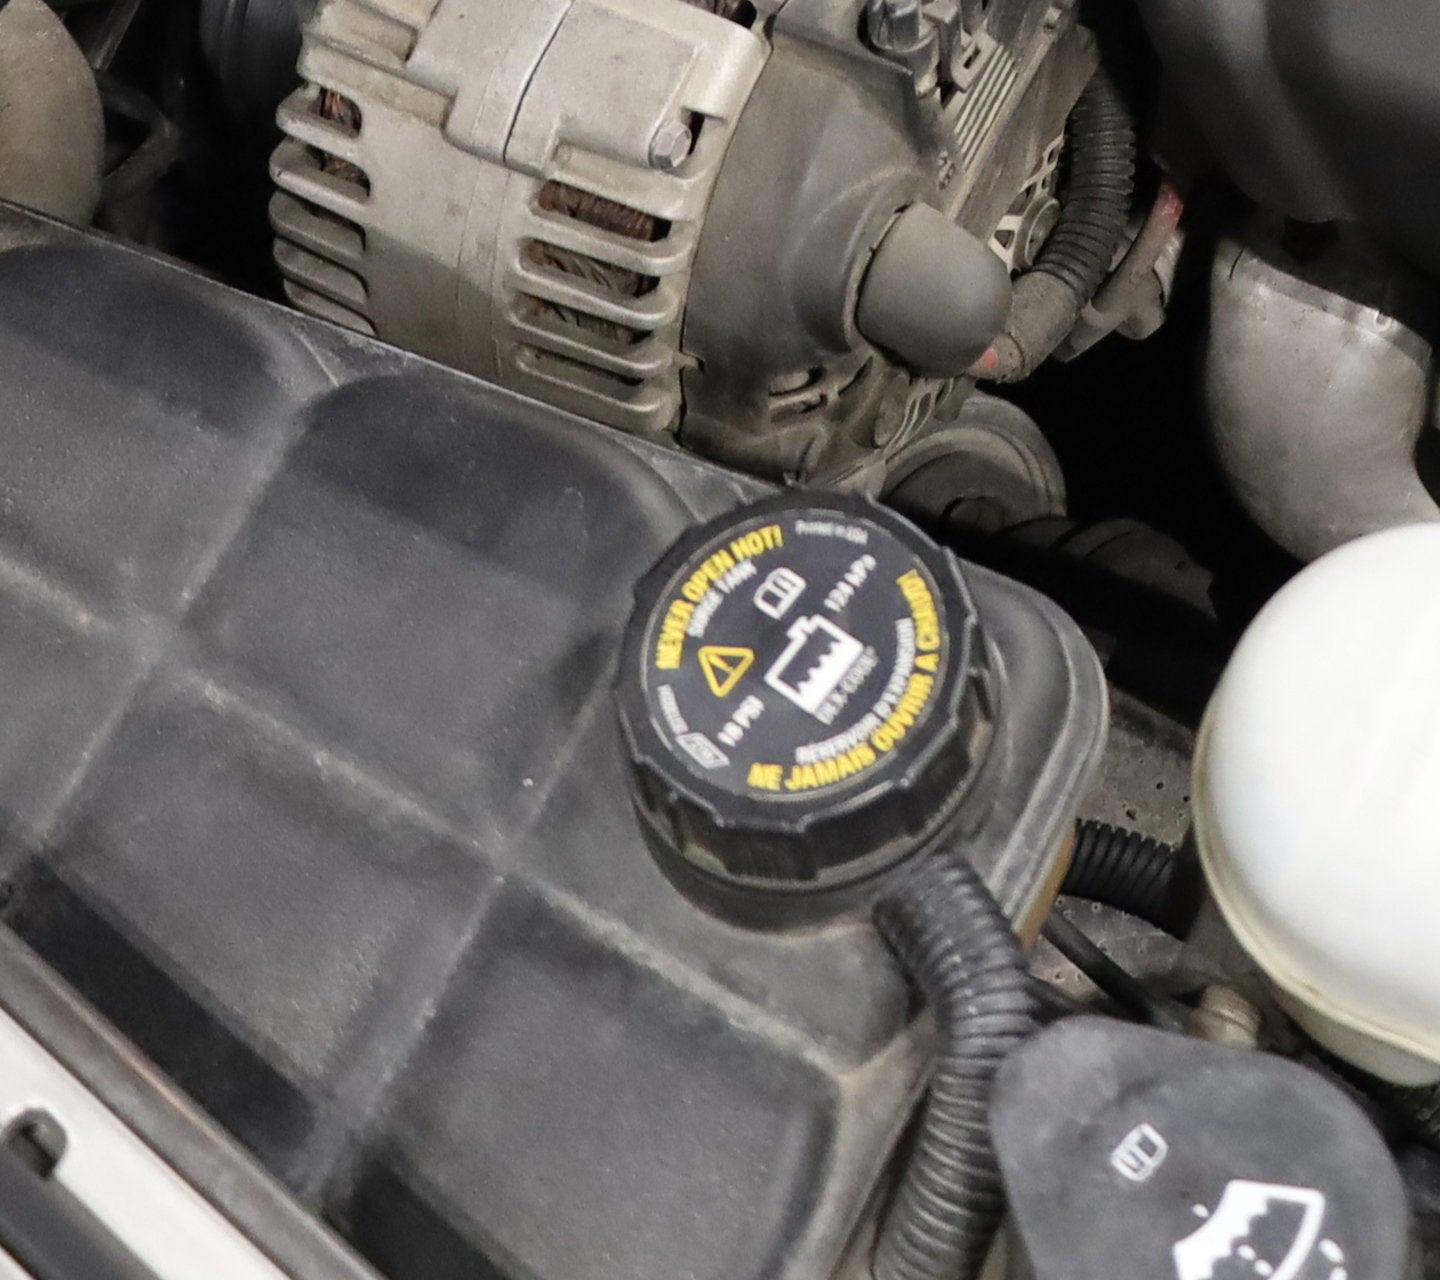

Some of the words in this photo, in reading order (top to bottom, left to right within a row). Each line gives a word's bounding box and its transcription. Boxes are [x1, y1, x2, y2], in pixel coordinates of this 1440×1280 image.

[656, 599, 695, 669] NEVER
[682, 550, 735, 602] OPEN
[730, 525, 784, 560] HOT!
[732, 695, 765, 729] PSI
[824, 582, 854, 612] 124
[747, 763, 783, 789] NE
[784, 742, 876, 791] JAMAIS
[871, 674, 935, 751] OUVRIR
